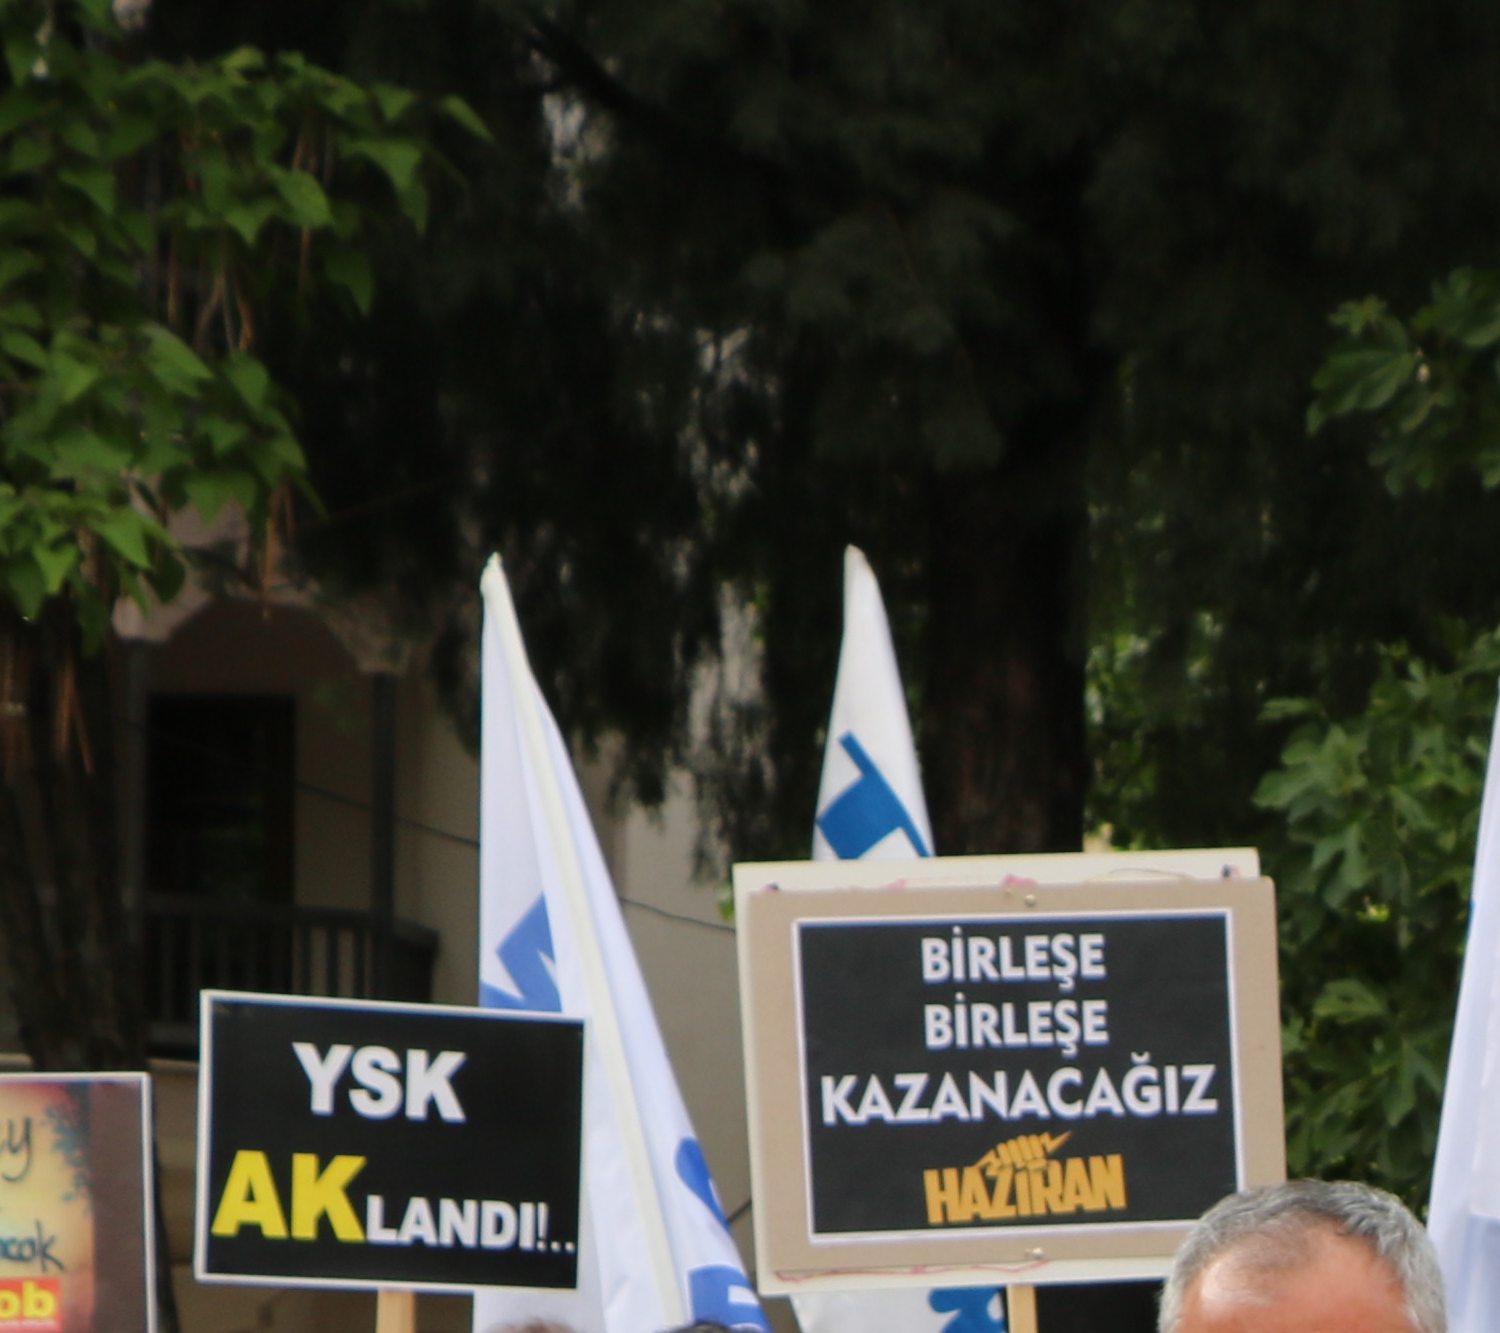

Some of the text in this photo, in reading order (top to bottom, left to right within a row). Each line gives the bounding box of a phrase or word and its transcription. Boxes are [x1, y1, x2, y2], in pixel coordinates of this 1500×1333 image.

[921, 927, 1106, 990] BİRLEŞE
[925, 993, 1109, 1056] BİRLEŞE
[292, 1042, 467, 1124] YSK
[820, 1052, 1218, 1125] KAZANACAĞIZ
